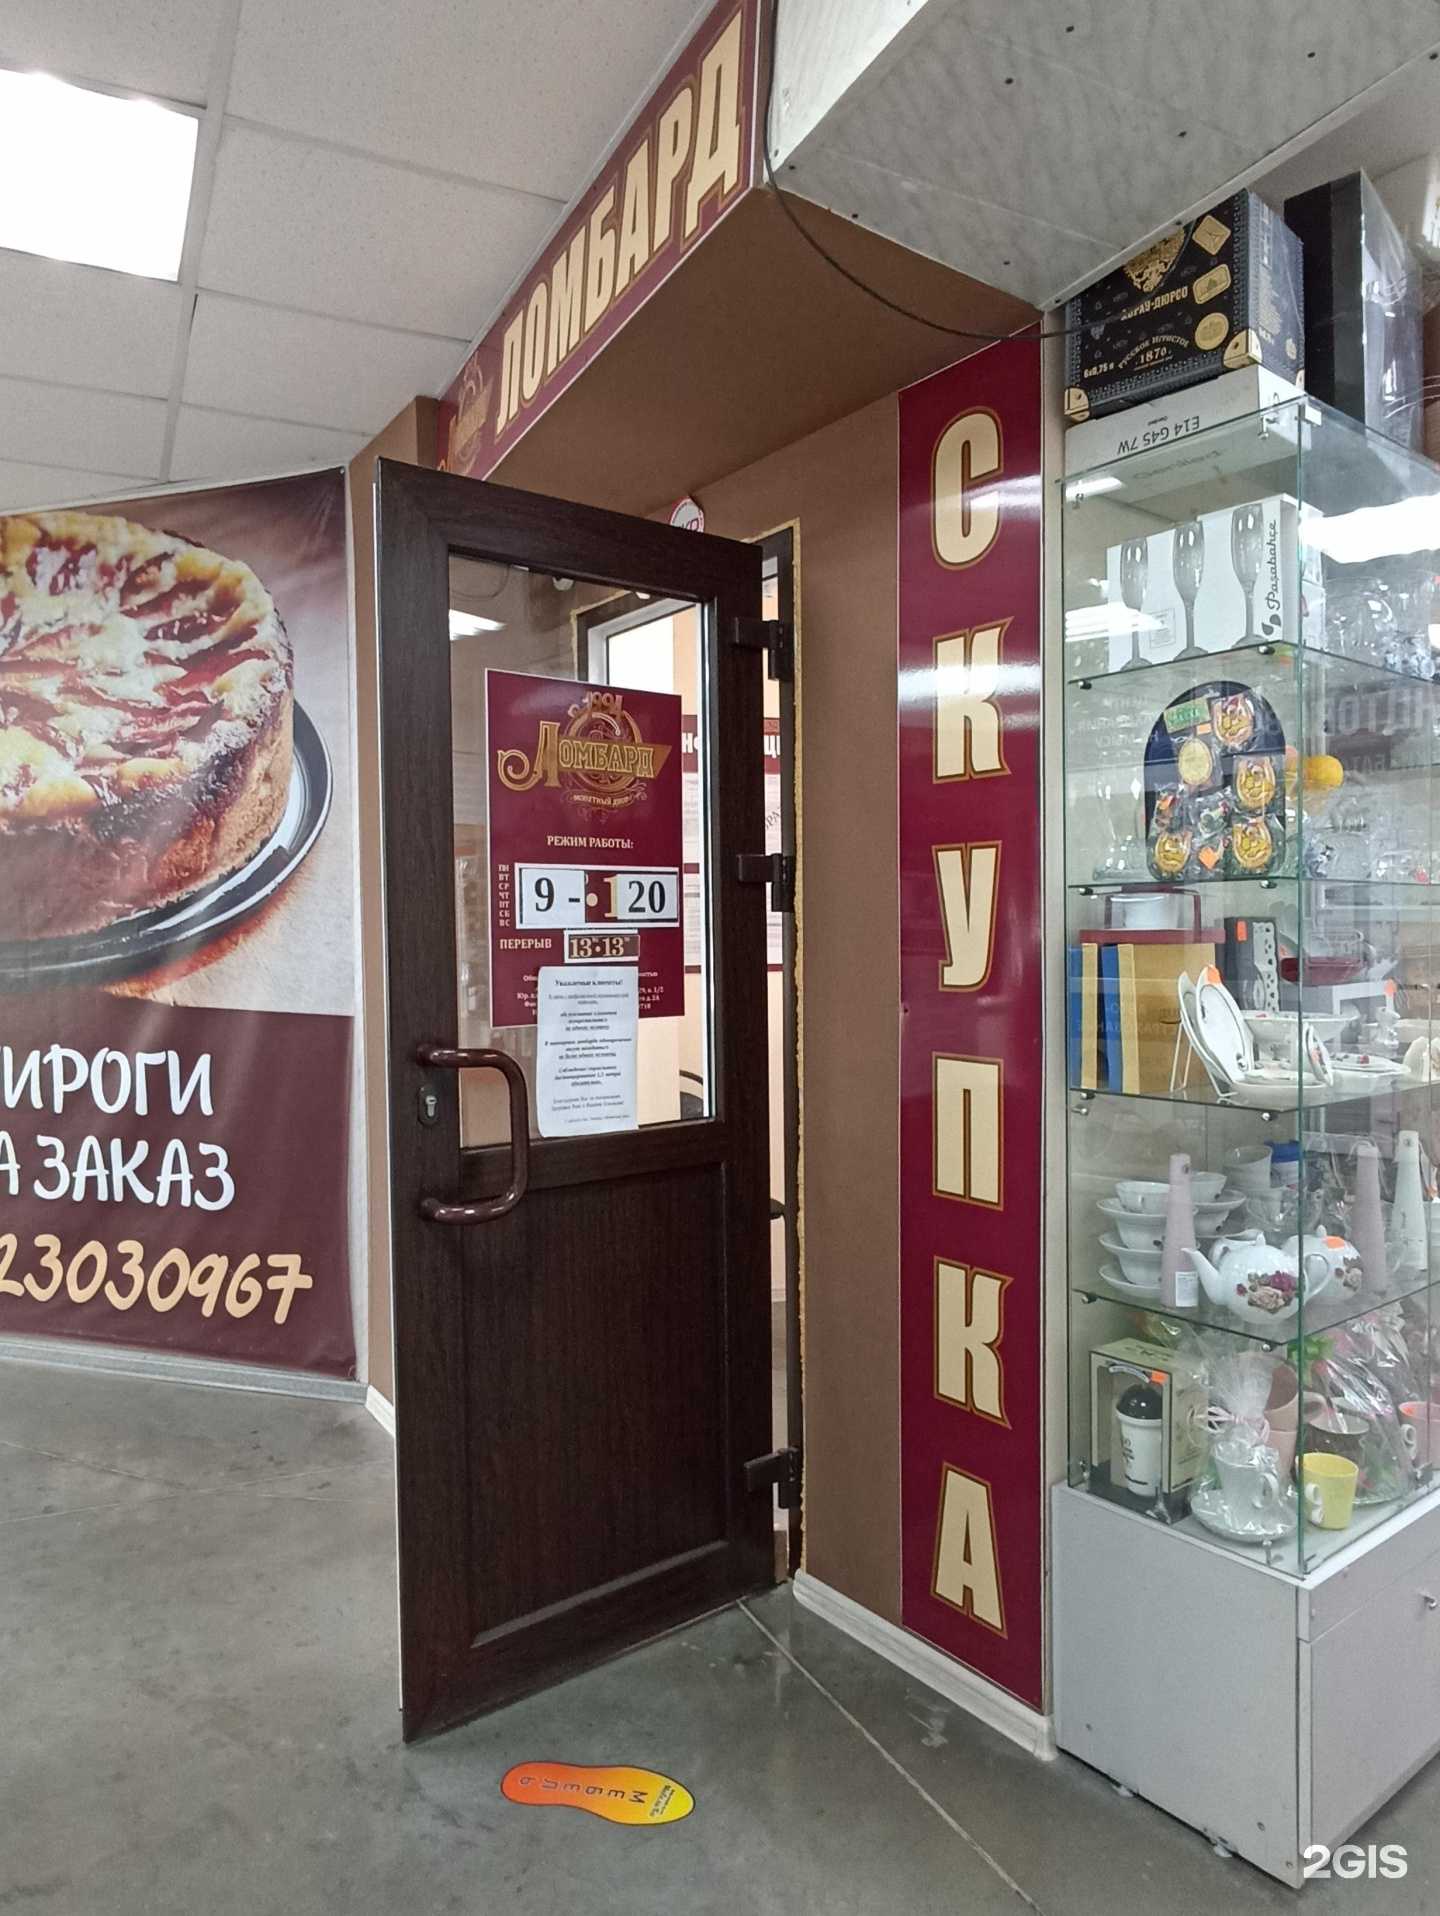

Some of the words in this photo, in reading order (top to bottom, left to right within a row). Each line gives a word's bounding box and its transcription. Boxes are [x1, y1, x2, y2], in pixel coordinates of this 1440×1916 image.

[495, 6, 744, 440] ЛОМБАРД
[1142, 427, 1170, 447] G45
[1174, 415, 1200, 437] E14
[1116, 436, 1138, 455] 7W
[547, 835, 587, 848] РЕЖИМ
[589, 837, 634, 850] РАБОТЫ:
[499, 938, 552, 950] ПЕРЕРЫВ
[931, 405, 1014, 1641] СКУПКА
[0, 1043, 214, 1116] ИРОГИ
[33, 1134, 236, 1211] ЗАКАЗ
